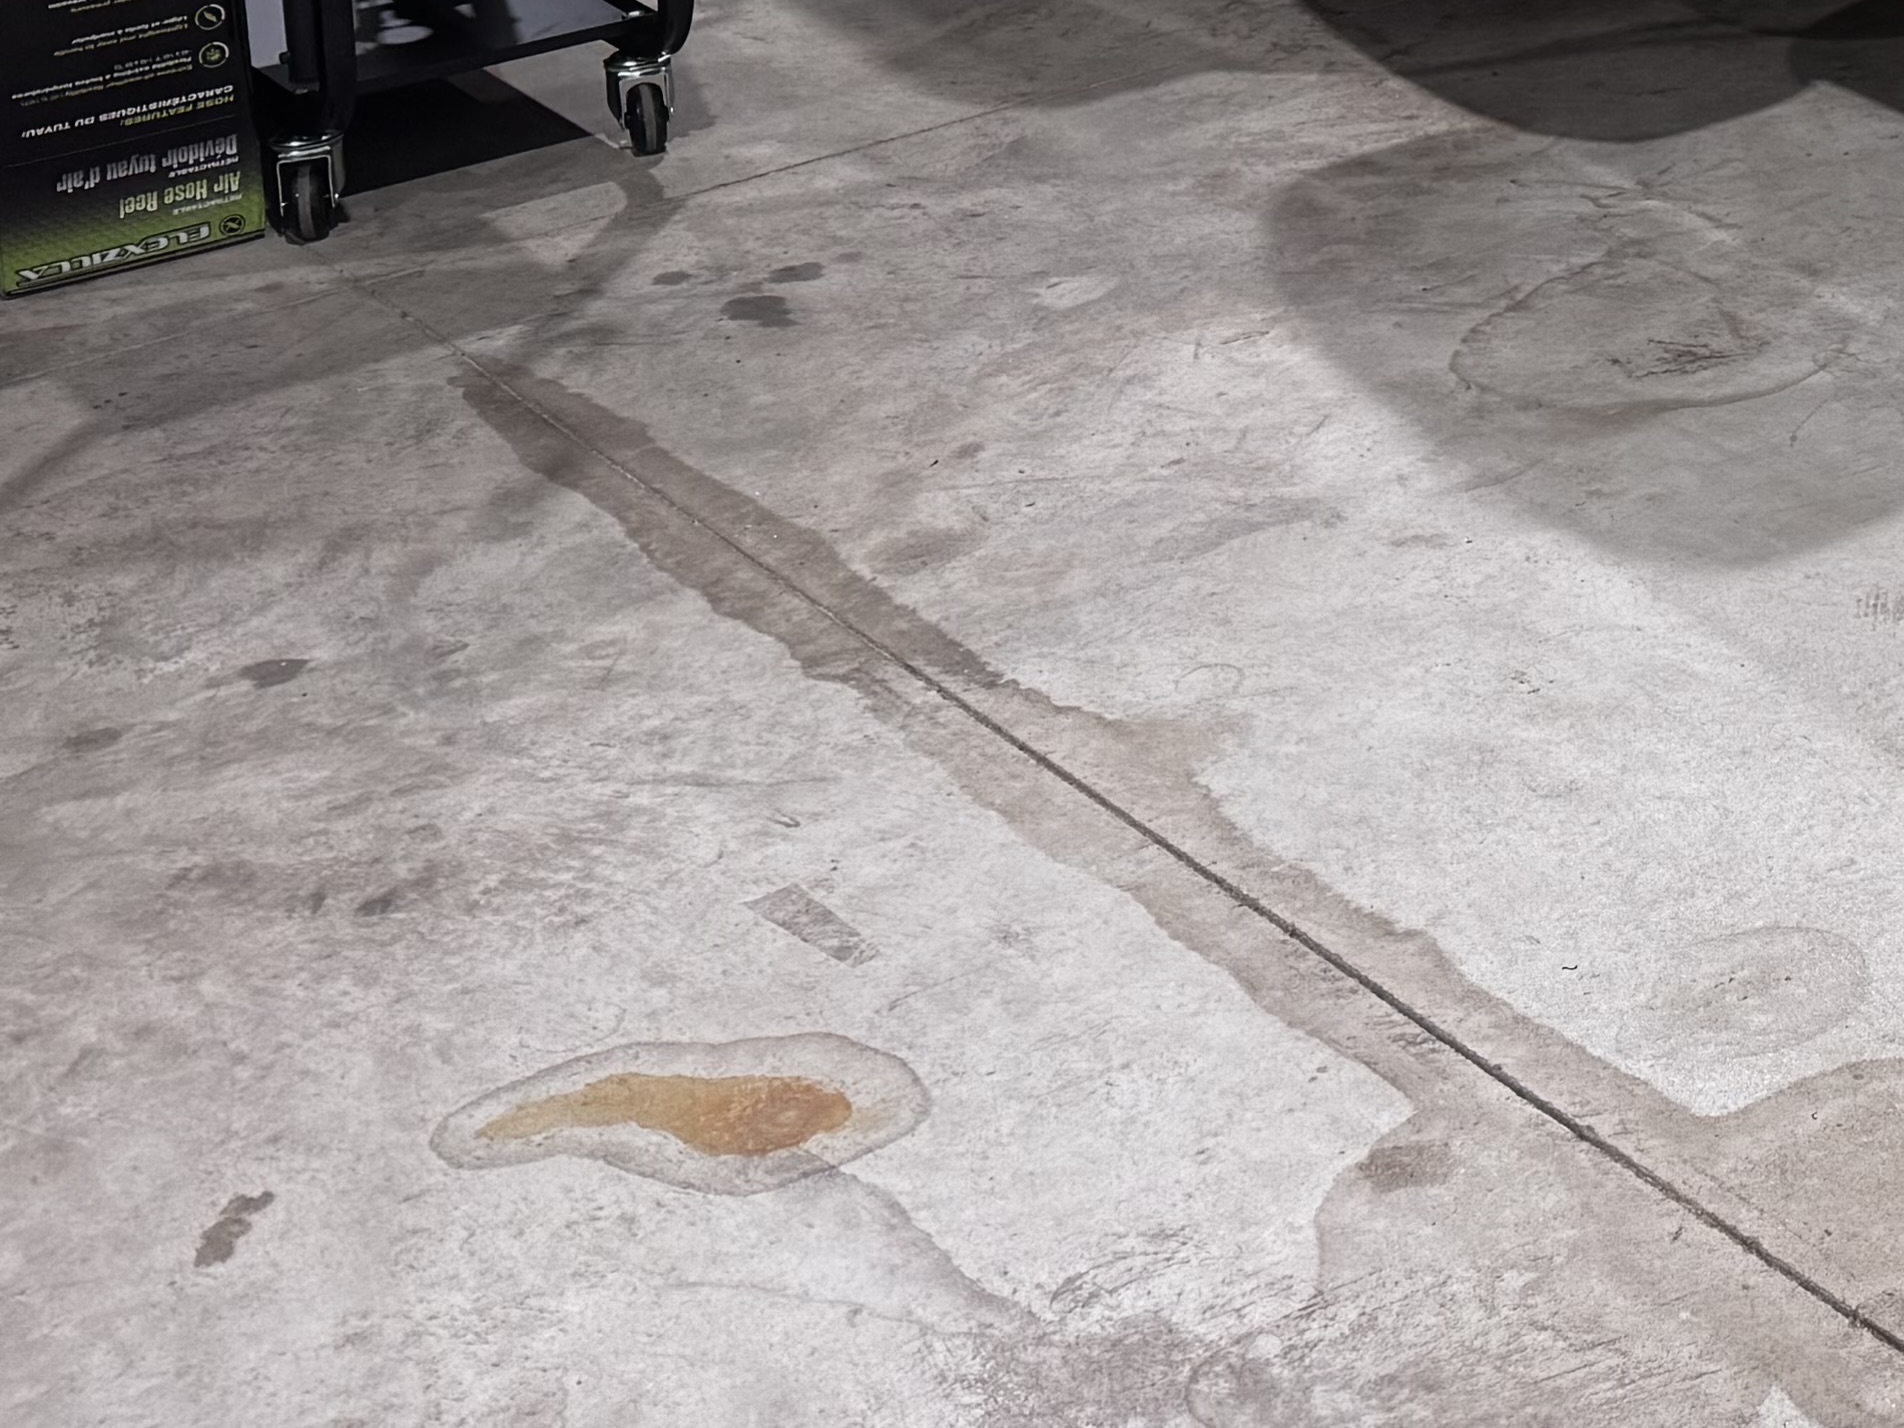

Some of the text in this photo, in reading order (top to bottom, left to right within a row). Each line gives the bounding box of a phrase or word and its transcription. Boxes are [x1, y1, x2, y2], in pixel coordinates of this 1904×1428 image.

[74, 115, 94, 129] DU
[98, 84, 234, 122] CARACTÉRISTIQUES
[196, 94, 234, 110] HOSE
[56, 133, 237, 195] Dévidoir tuyau d'air
[119, 171, 240, 219] Air Hose Reel
[15, 222, 211, 282] FLEXZILLA
